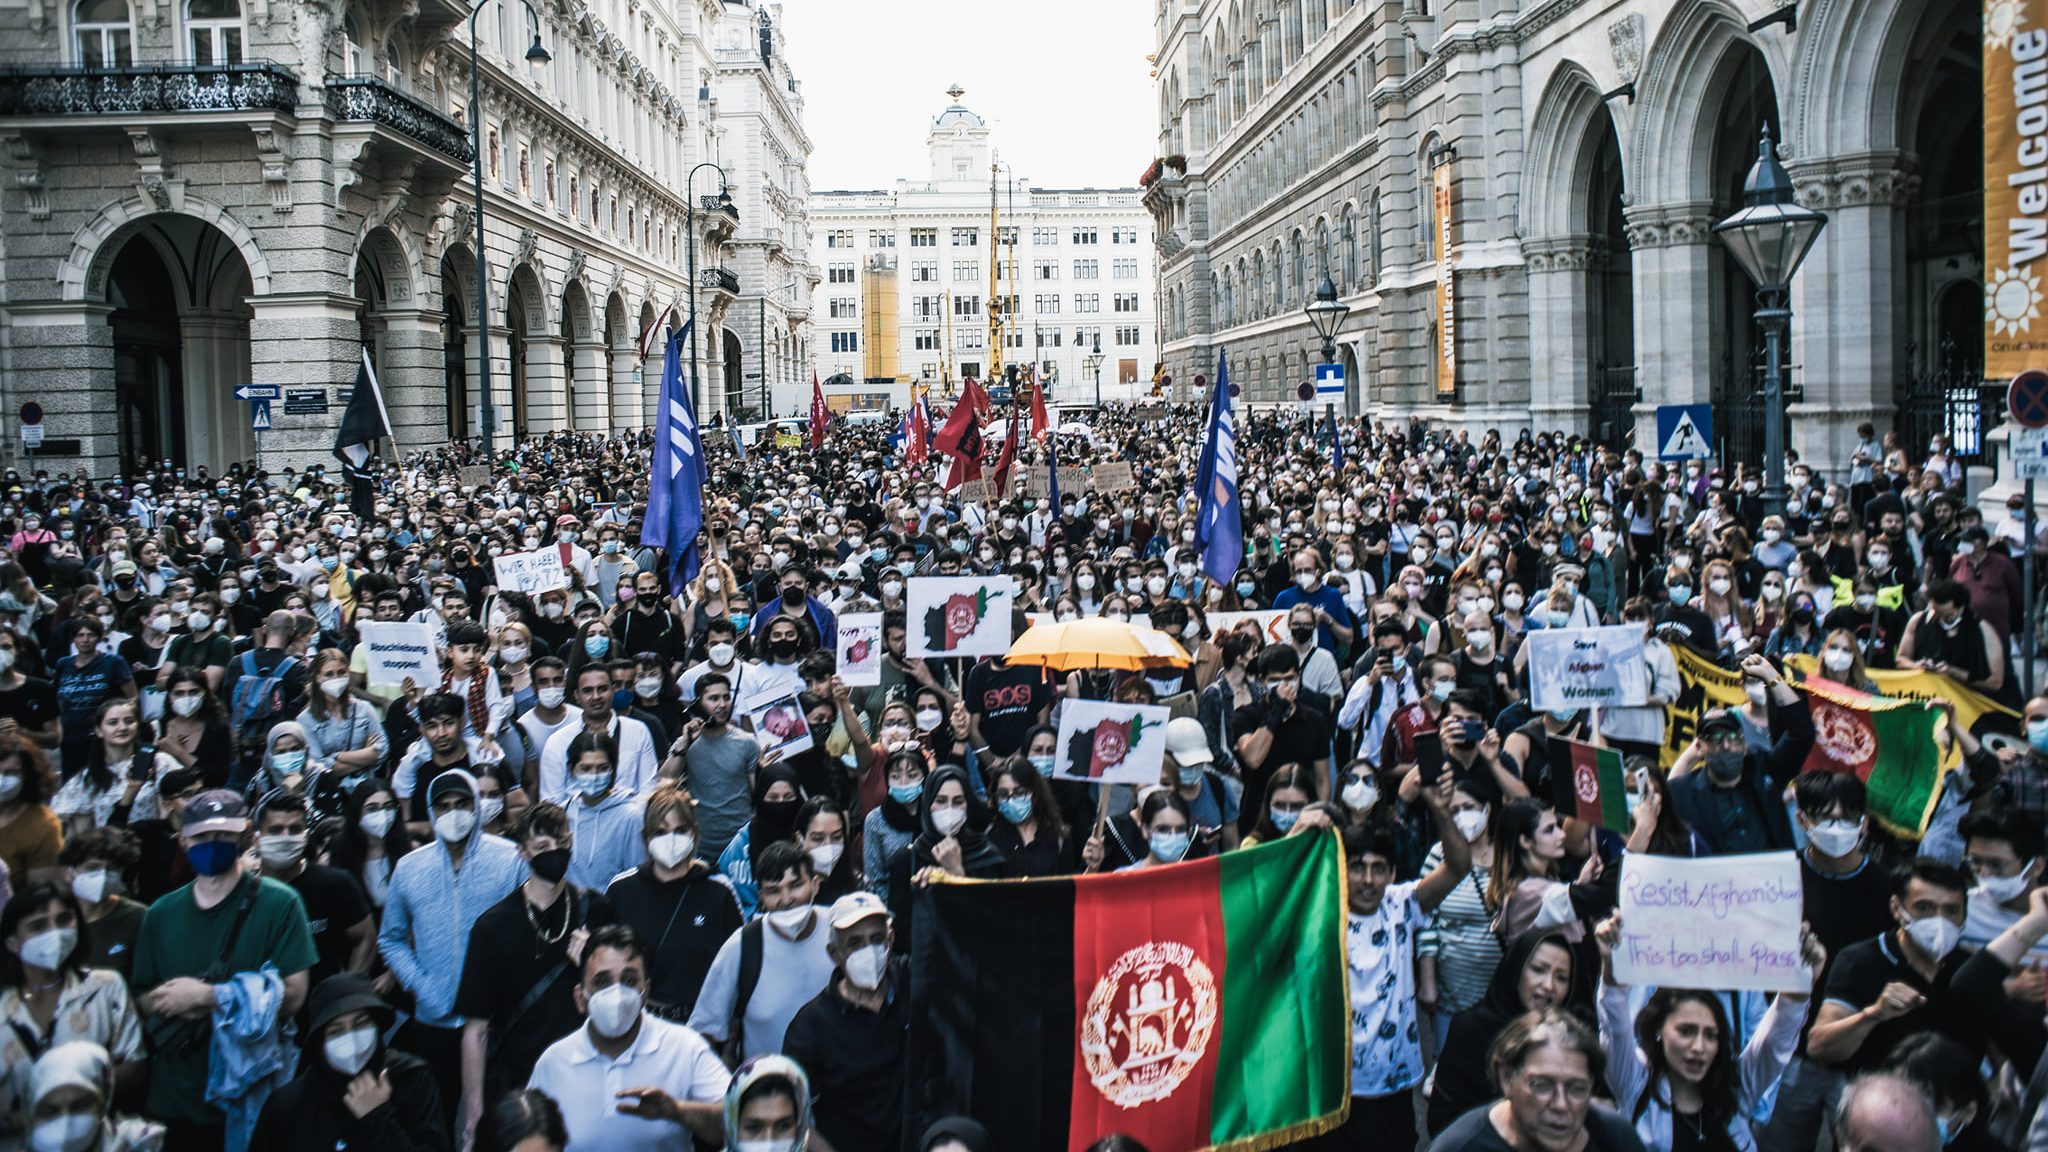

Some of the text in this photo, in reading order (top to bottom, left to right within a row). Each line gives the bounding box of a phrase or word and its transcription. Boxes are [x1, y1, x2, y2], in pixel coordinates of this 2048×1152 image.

[2008, 27, 2048, 270] Welcome
[1443, 215, 1455, 358] Willkommen
[248, 388, 274, 396] EINBAHN
[498, 553, 558, 575] WIR HABEN
[370, 643, 429, 655] Abschiebung
[1573, 640, 1598, 650] Save
[1568, 661, 1605, 674] Afghan
[984, 684, 1031, 710] SOS
[1561, 685, 1616, 698] Woman
[1622, 932, 1665, 967] This
[1667, 936, 1698, 969] too
[1701, 935, 1743, 965] shall
